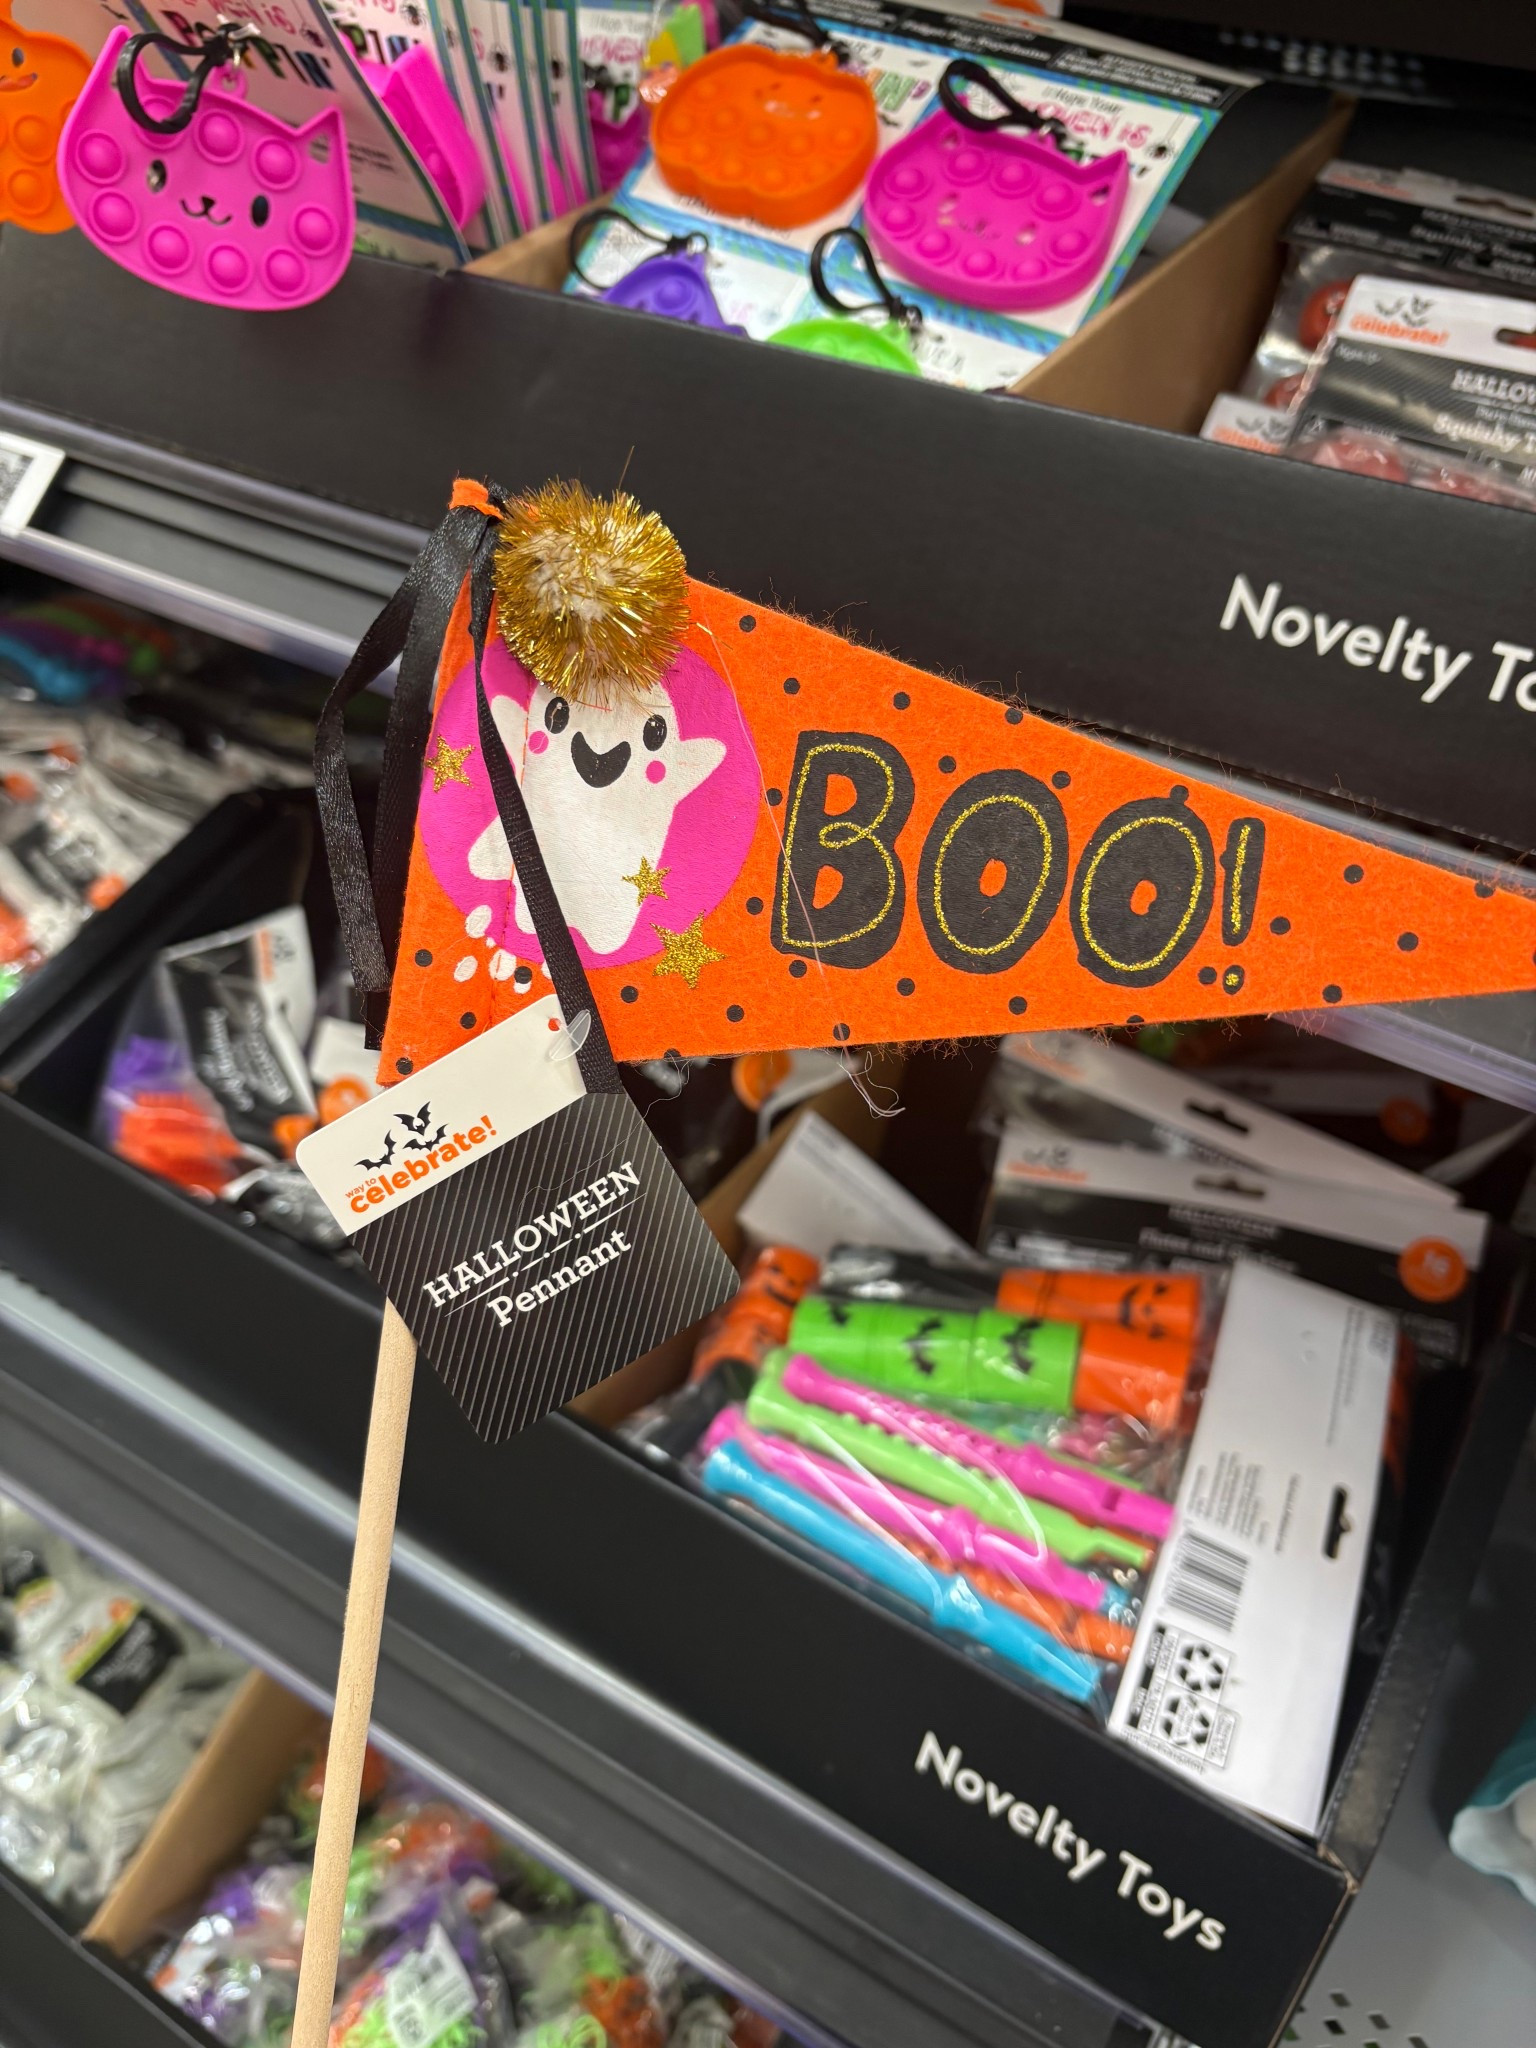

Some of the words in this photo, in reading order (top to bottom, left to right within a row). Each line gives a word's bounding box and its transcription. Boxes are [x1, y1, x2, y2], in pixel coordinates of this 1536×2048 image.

[1219, 572, 1474, 704] Novelty
[771, 730, 1265, 994] BOO!
[345, 1183, 365, 1199] way
[365, 1177, 377, 1188] to
[350, 1115, 497, 1213] celebrate!
[423, 1161, 640, 1308] HALLOWEEN
[487, 1230, 632, 1328] Pennant
[914, 1730, 1107, 1882] Novelty
[1117, 1850, 1227, 1953] Toys
